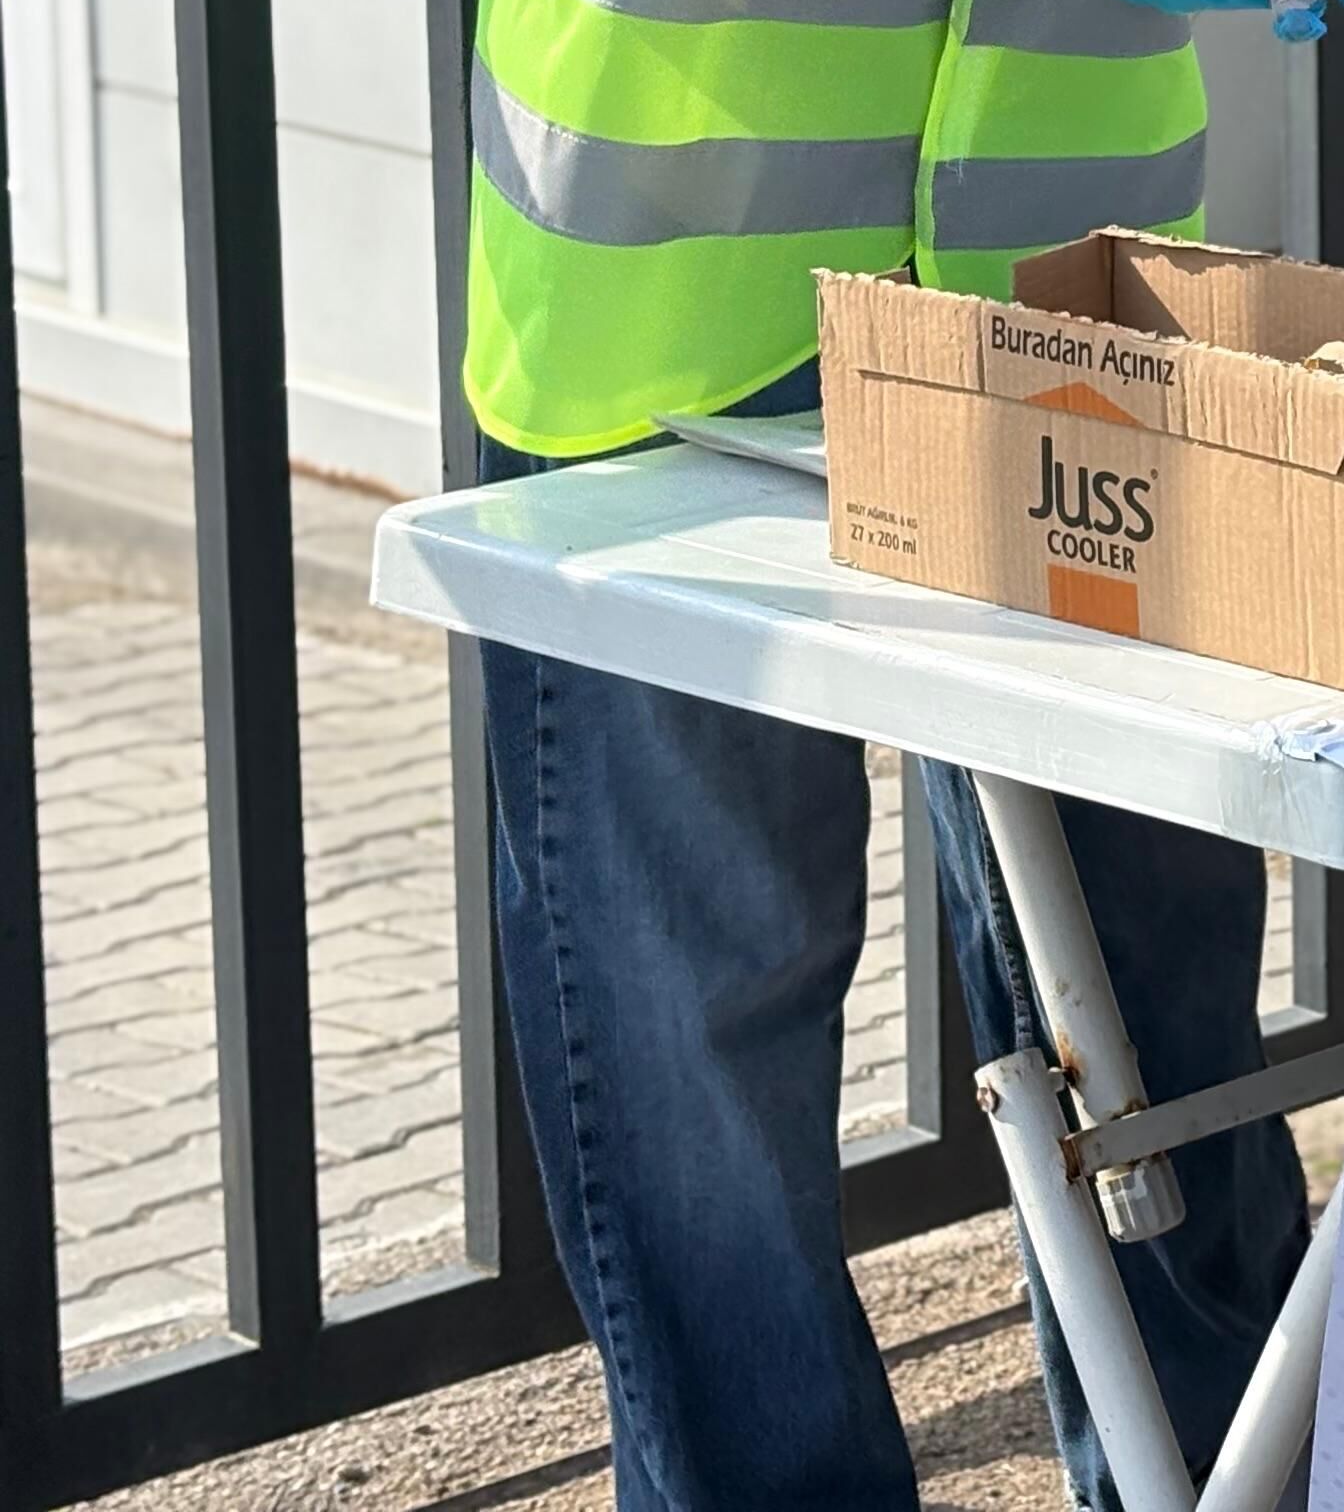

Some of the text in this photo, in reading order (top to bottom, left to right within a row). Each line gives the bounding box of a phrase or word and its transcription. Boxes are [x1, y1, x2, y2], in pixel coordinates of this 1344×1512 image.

[991, 315, 1176, 387] Buradan Açınız
[1028, 436, 1155, 542] Juss
[850, 522, 917, 555] 27 x 200 ml
[1047, 529, 1137, 573] COOLER
